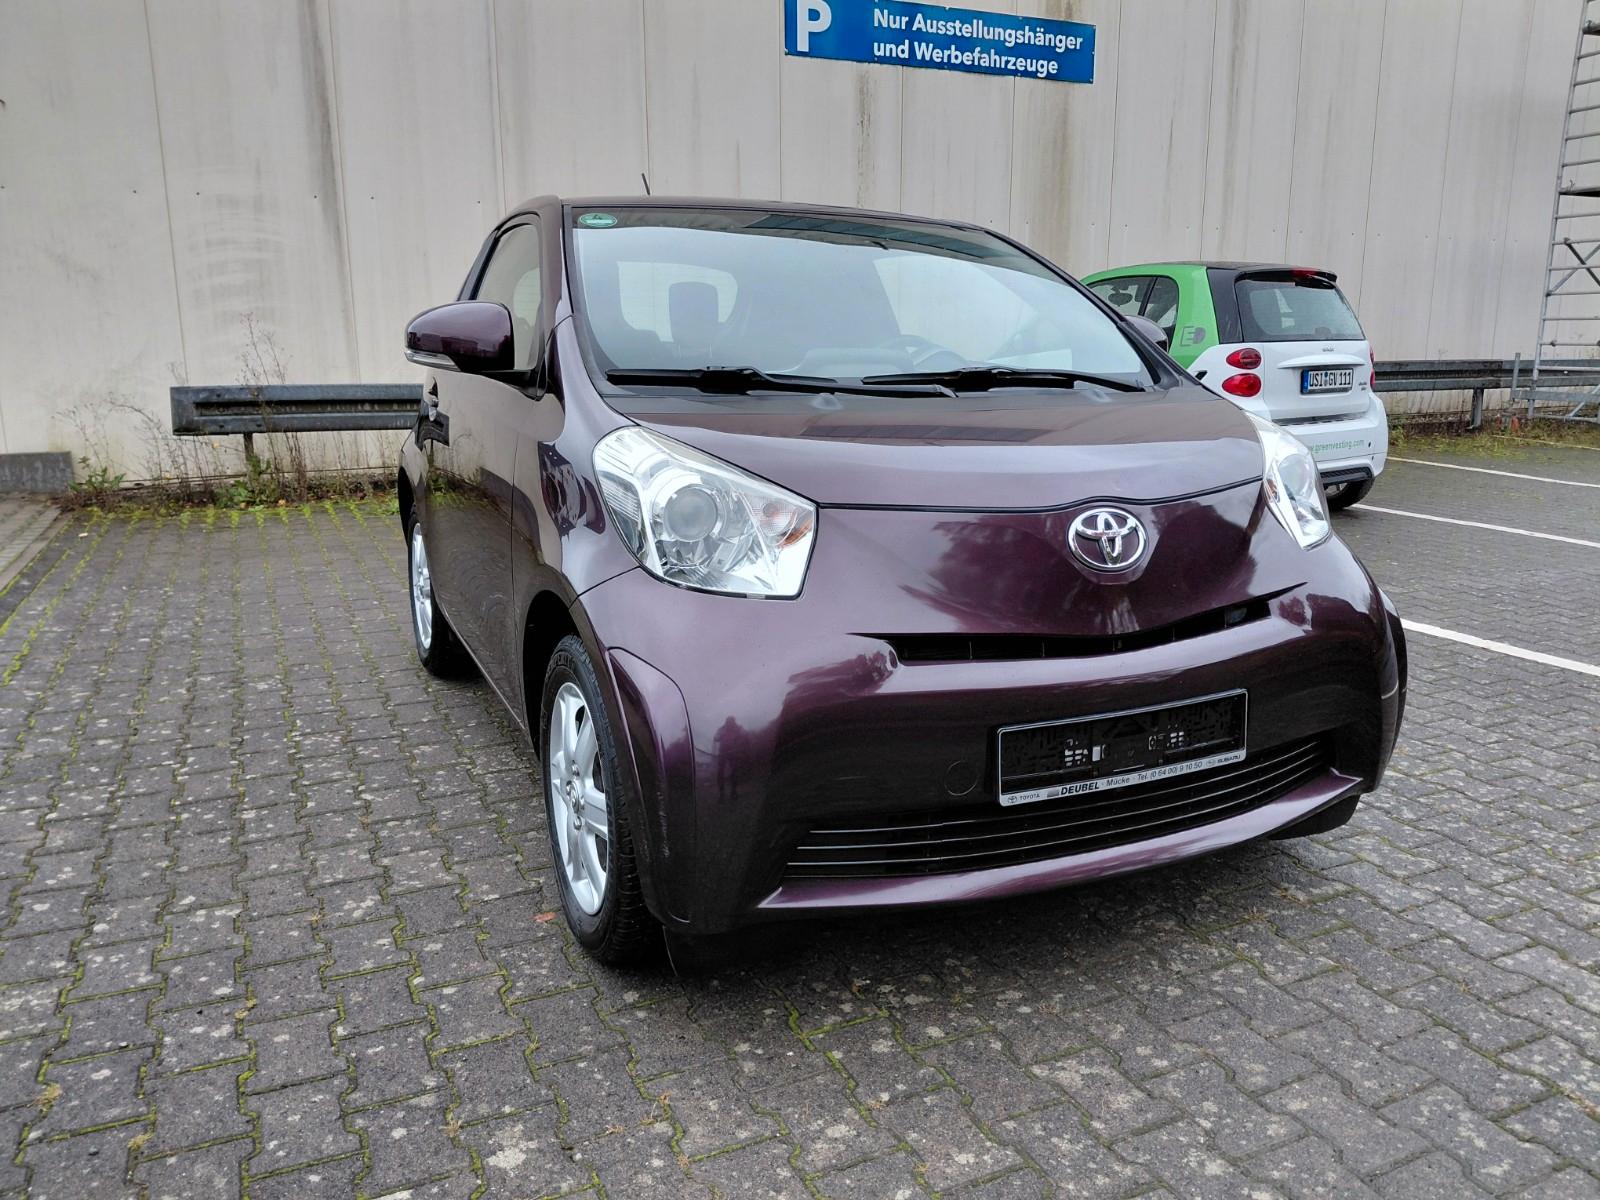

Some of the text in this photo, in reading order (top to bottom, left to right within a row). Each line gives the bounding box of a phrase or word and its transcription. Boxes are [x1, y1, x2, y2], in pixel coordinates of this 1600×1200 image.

[796, 0, 832, 52] P
[873, 8, 1083, 51] Nur Ausstellungshänger
[873, 40, 1059, 78] und Werbefahrzeuge
[1309, 371, 1323, 387] USI
[1328, 371, 1338, 386] GV
[1338, 371, 1351, 386] 111
[1019, 793, 1040, 801] TOYOTA
[1060, 781, 1099, 796] DEUBEL
[1106, 776, 1130, 787] Mücke
[1138, 772, 1149, 780] Tel.
